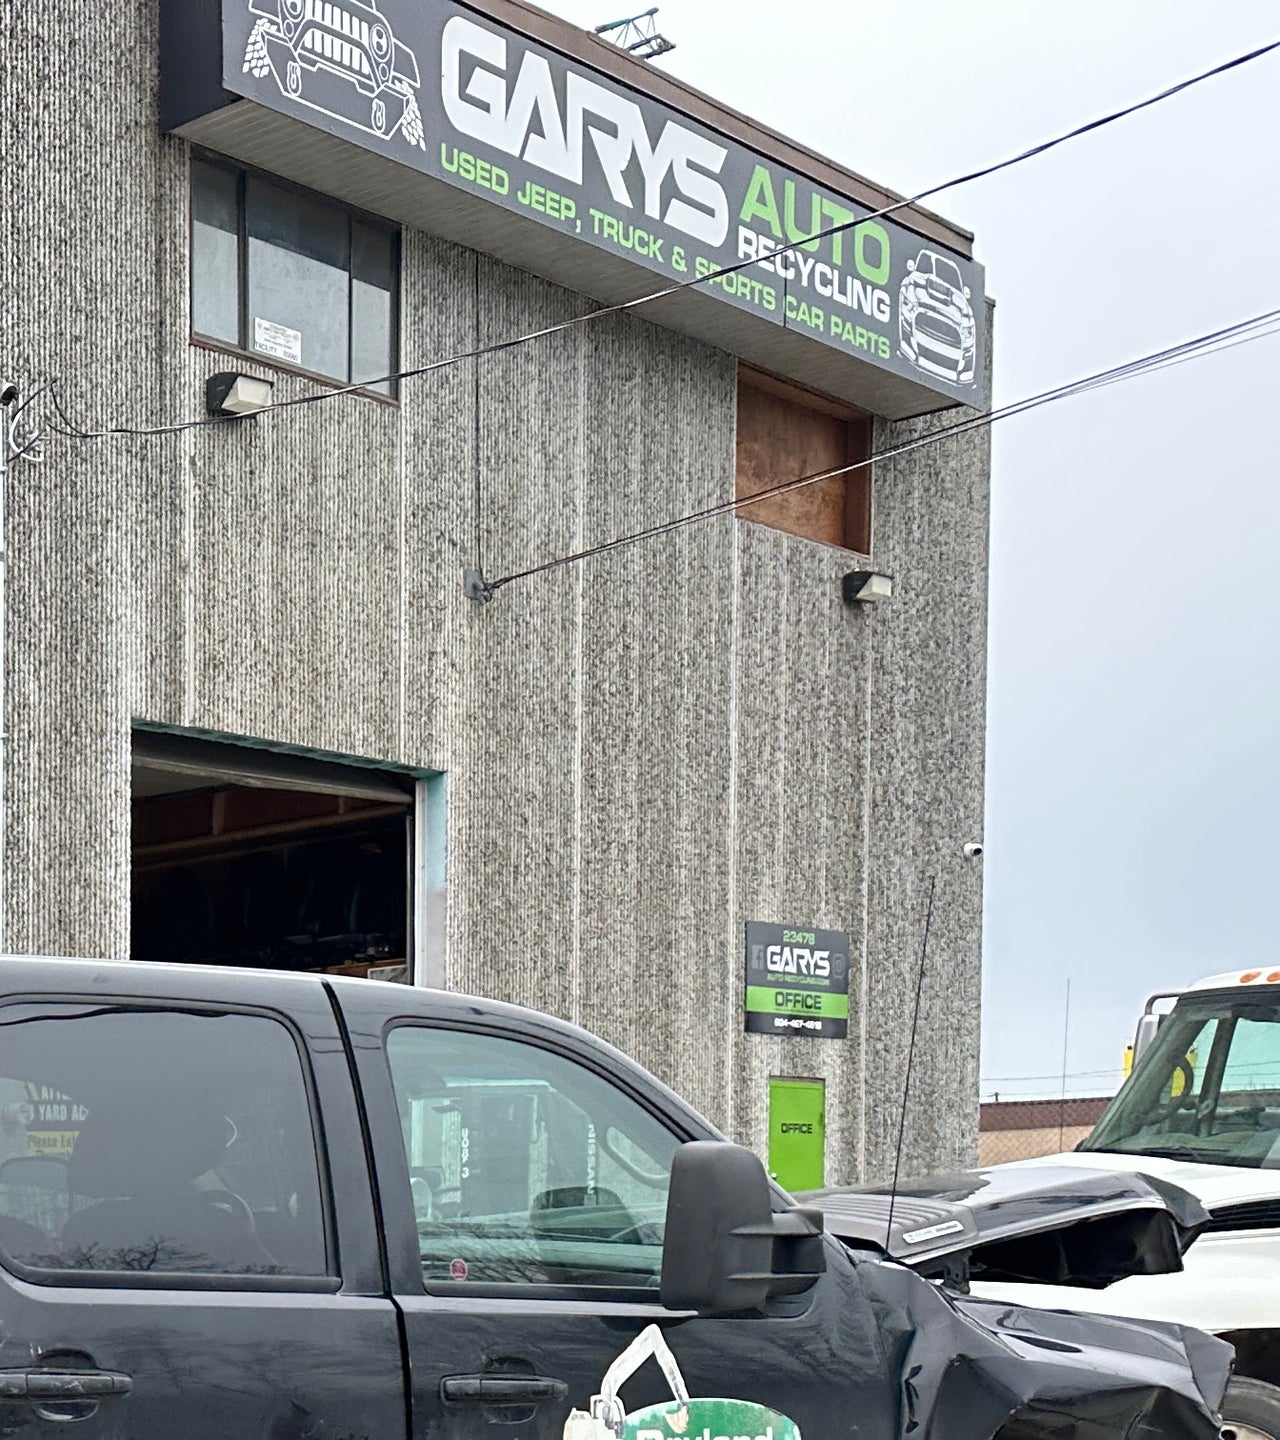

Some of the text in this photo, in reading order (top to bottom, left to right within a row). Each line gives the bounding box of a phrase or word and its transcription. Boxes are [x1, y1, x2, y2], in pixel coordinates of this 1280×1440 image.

[441, 16, 729, 247] GARYS
[441, 143, 890, 360] USED JEEP, TRUCK & SPORTS CAR PARTS
[738, 225, 890, 323] RECYCLING
[740, 164, 890, 286] AUTO
[767, 945, 830, 977] GARYS
[775, 991, 821, 1010] OFFICE
[781, 1123, 813, 1135] OFFICE
